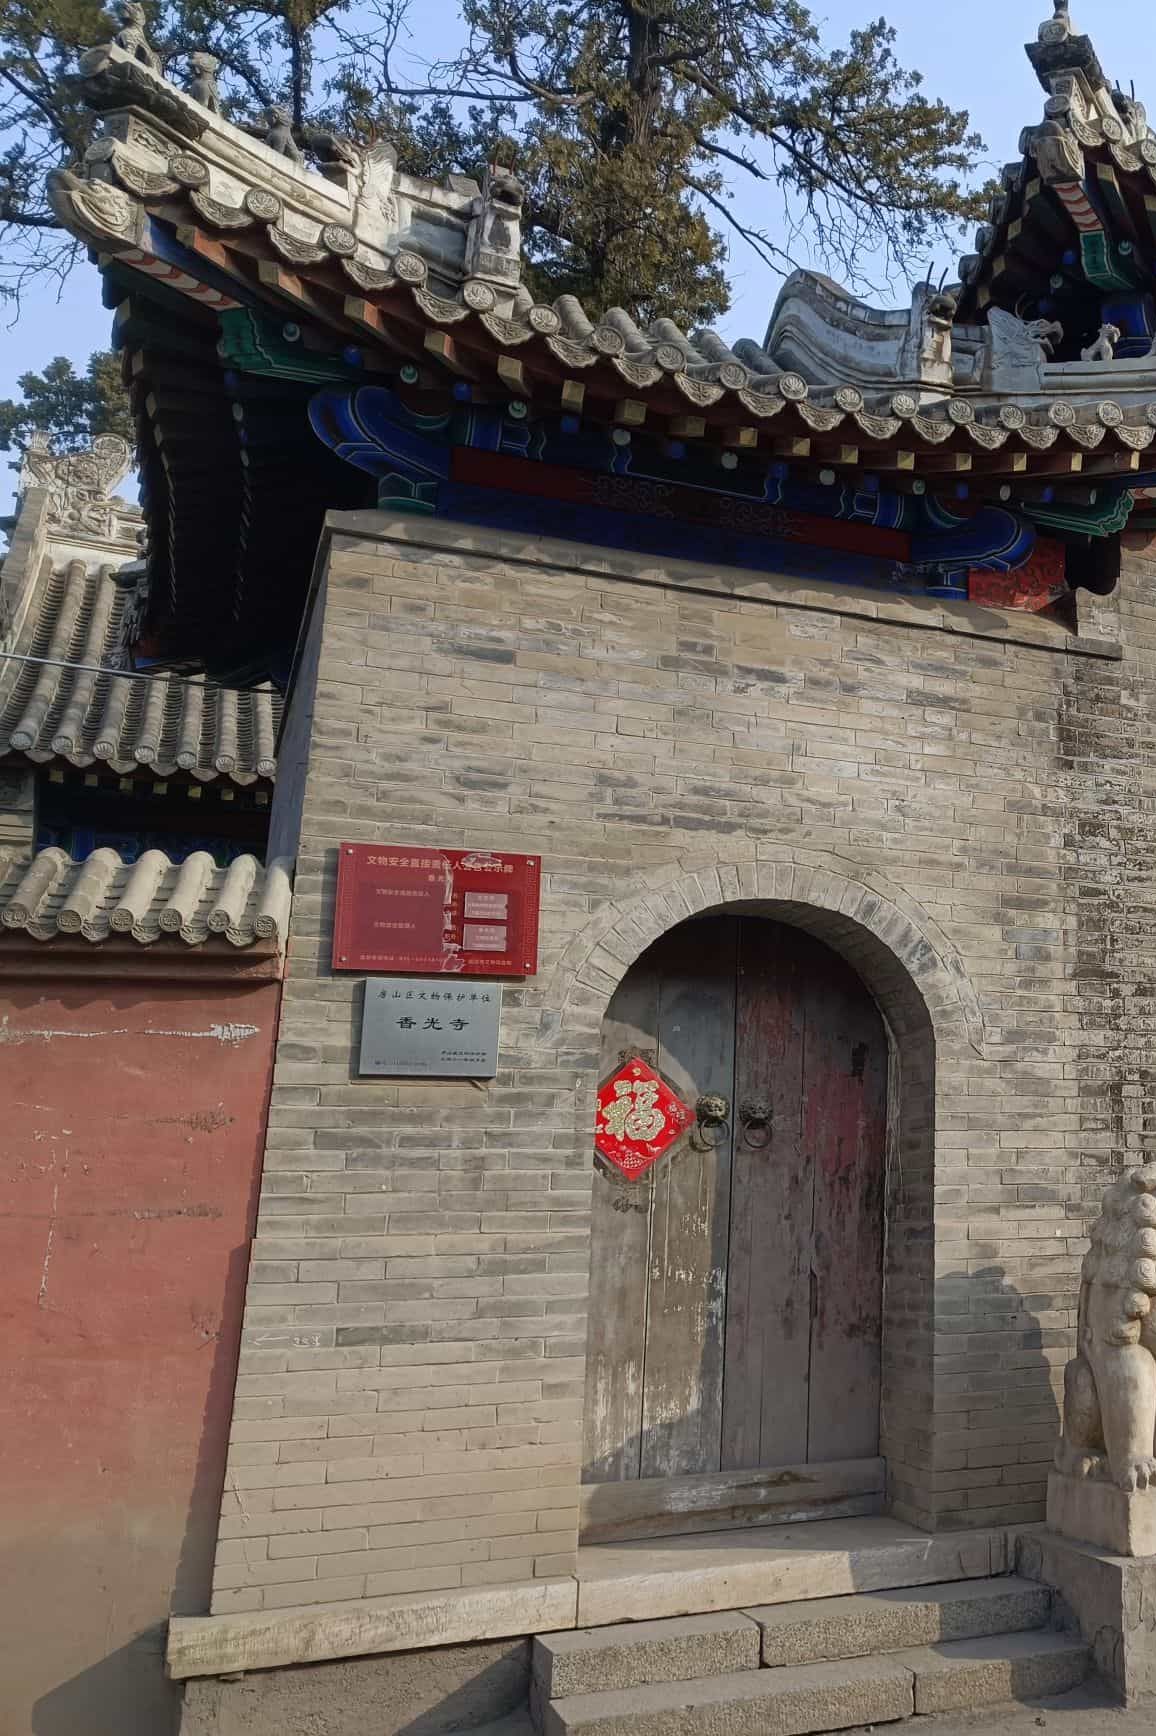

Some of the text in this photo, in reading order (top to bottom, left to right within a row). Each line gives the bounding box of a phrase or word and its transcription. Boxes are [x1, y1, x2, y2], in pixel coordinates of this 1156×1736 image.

[395, 1016, 470, 1031] 香光寺
[602, 1079, 666, 1142] 福
